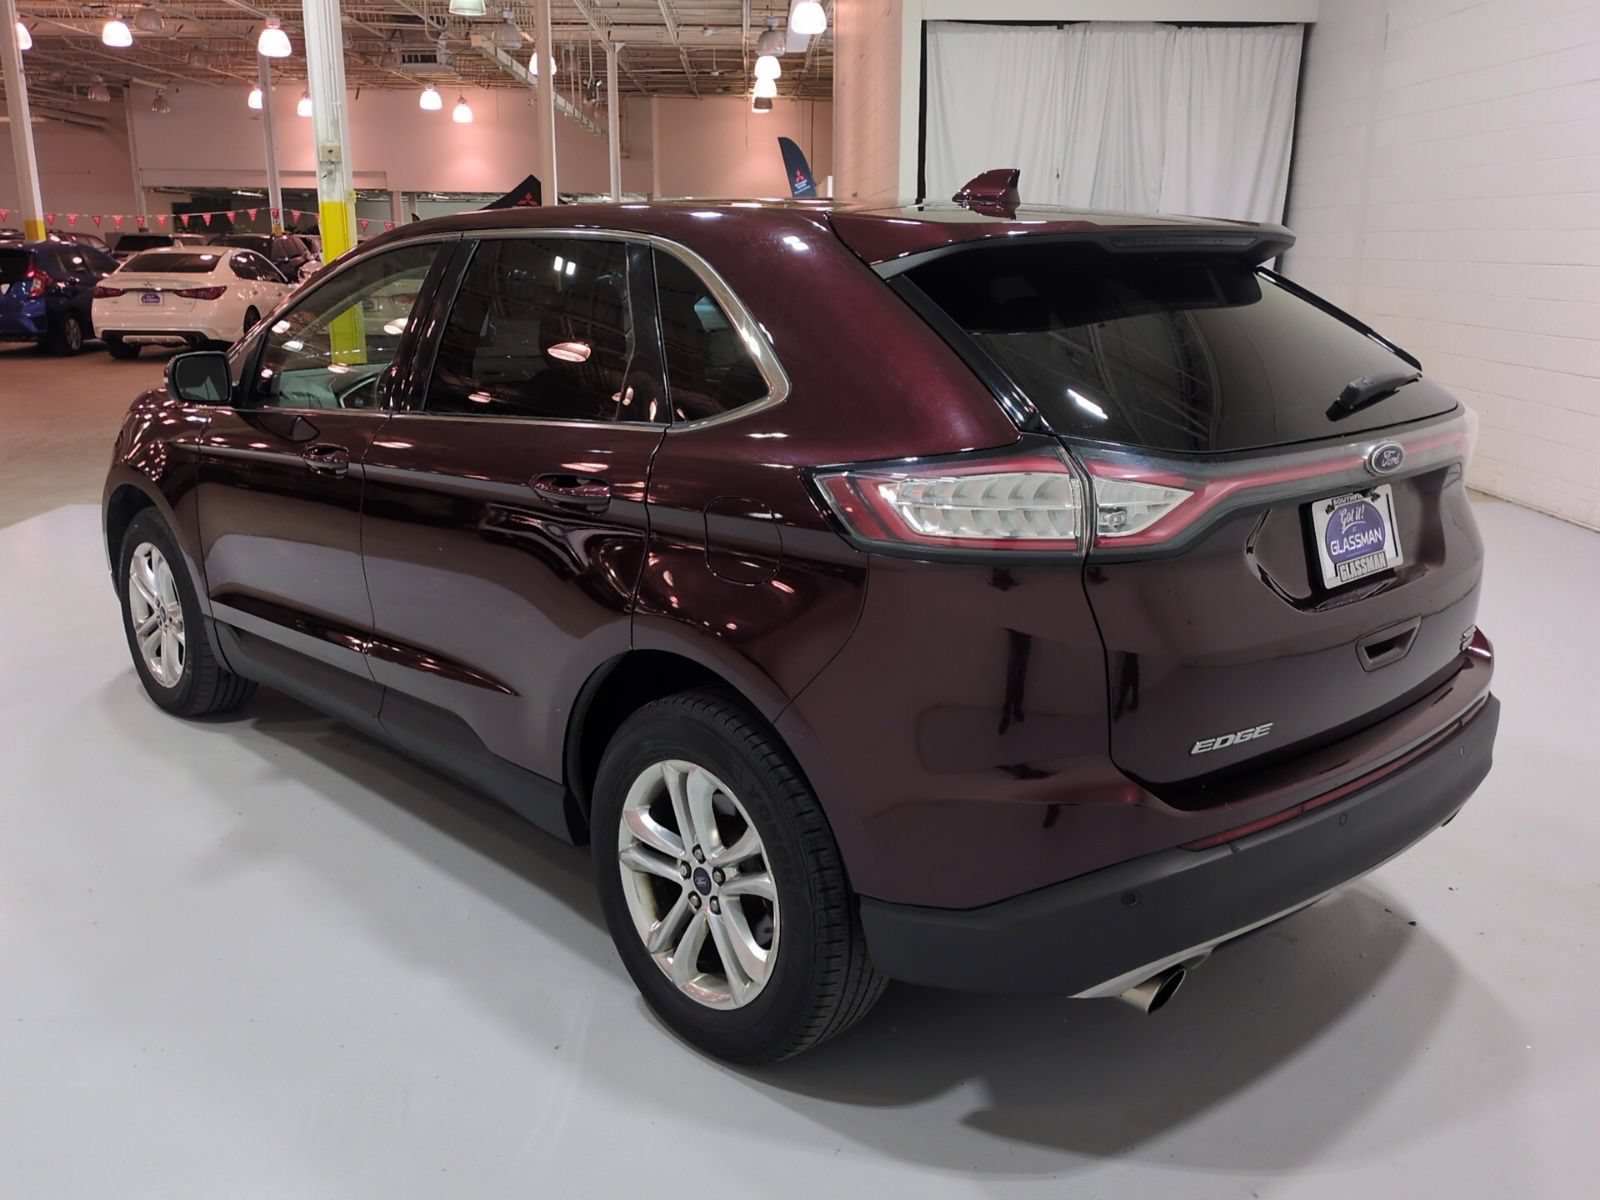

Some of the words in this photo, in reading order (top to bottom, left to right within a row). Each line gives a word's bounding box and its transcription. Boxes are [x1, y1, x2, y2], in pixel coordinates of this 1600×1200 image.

[1381, 449, 1401, 468] Ford
[1340, 506, 1355, 527] Got
[1355, 504, 1366, 521] it!
[1330, 528, 1383, 556] GLASSMAN
[1338, 551, 1387, 580] GLASSMAN
[1190, 722, 1274, 755] EDGE
